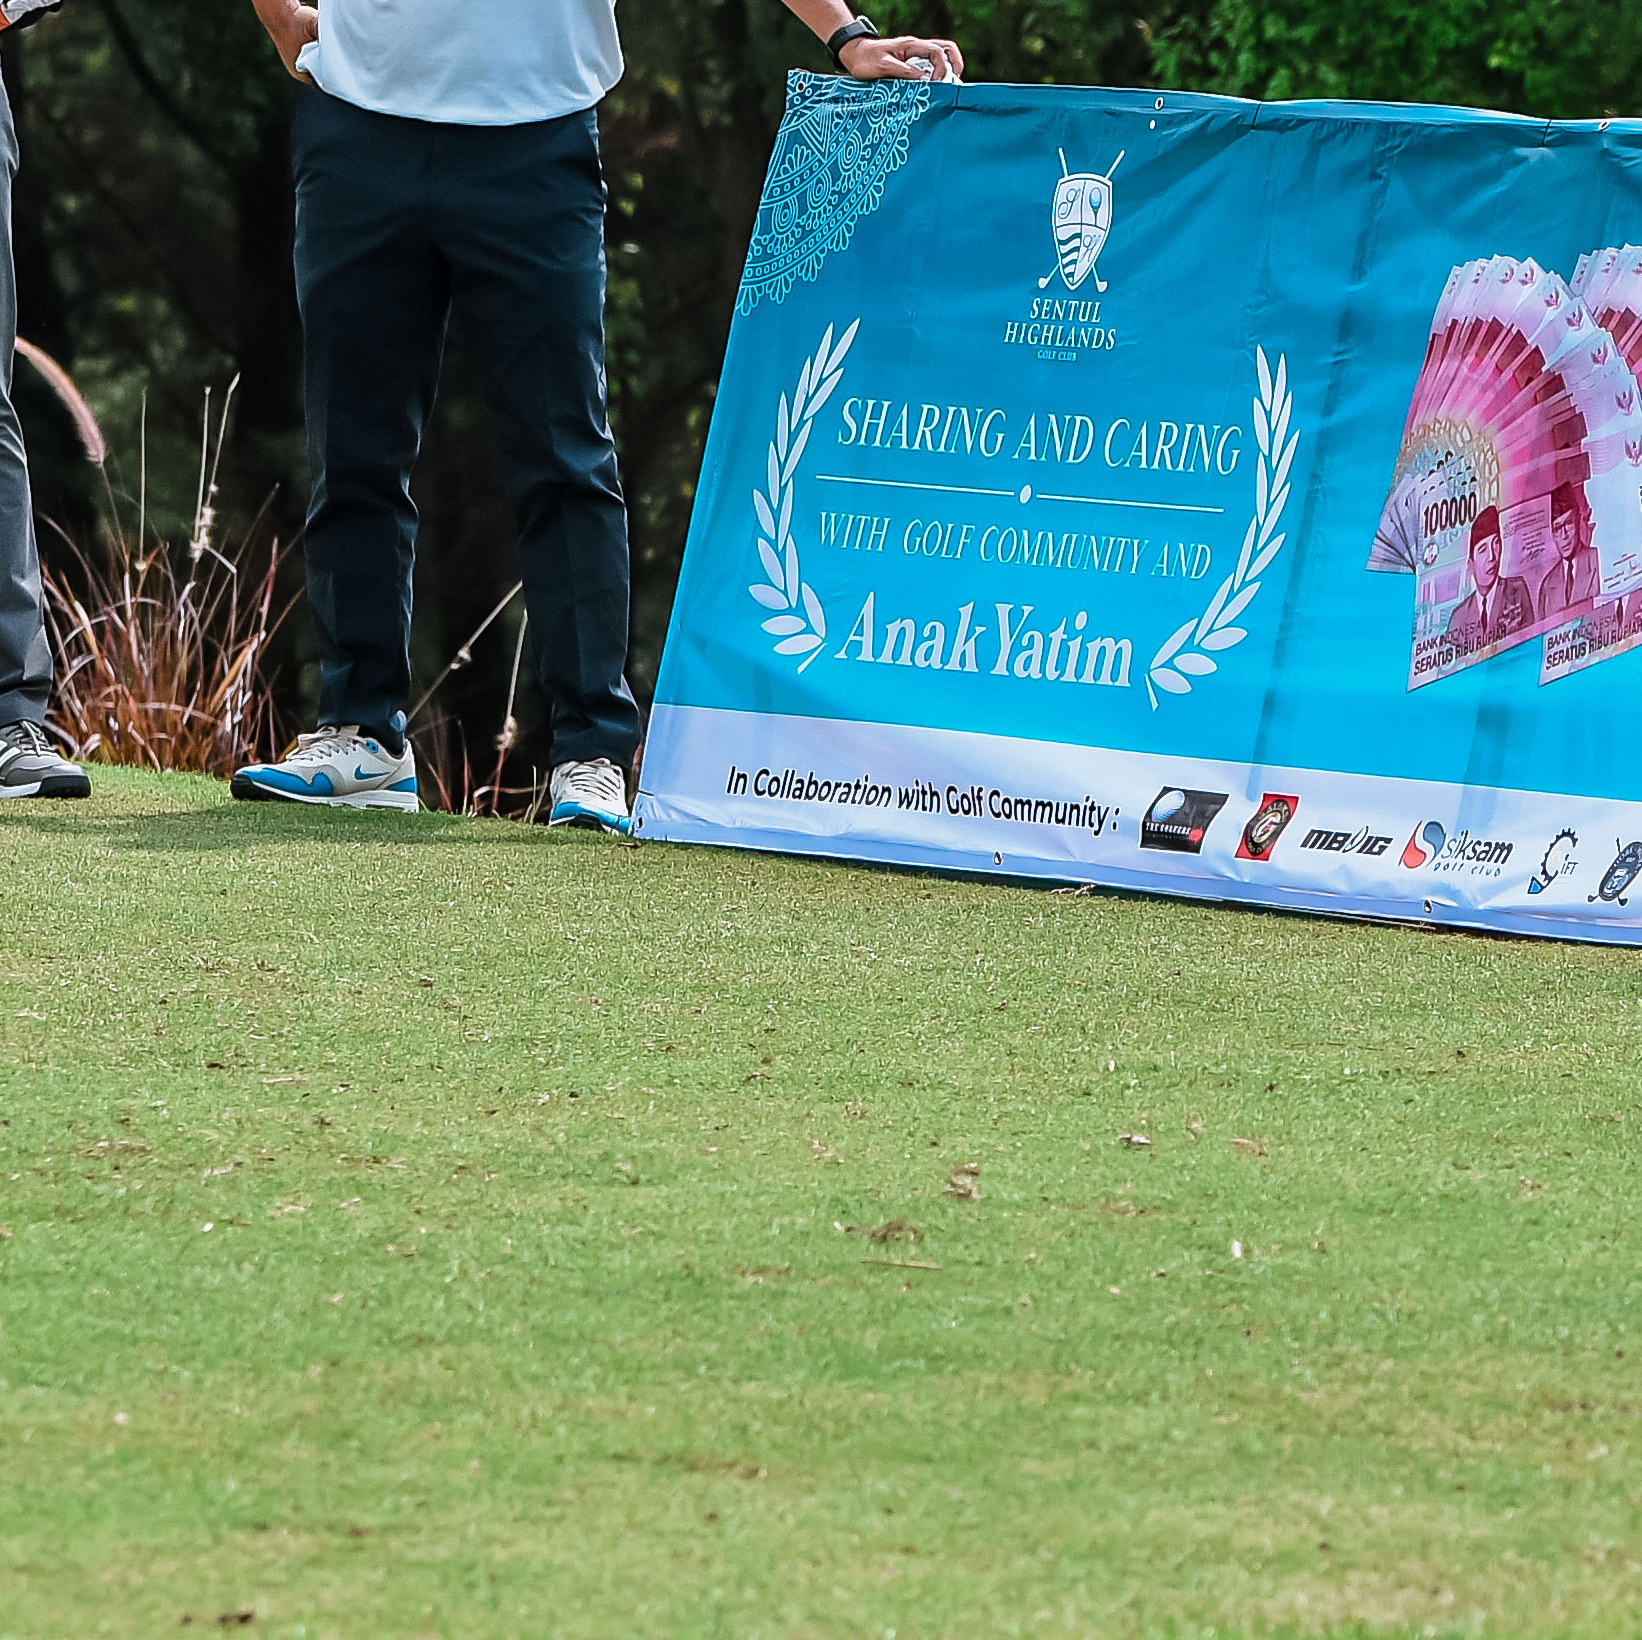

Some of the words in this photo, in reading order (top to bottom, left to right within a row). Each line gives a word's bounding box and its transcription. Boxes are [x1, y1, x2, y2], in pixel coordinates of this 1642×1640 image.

[1030, 297, 1101, 324] SENTUL
[1004, 322, 1117, 351] HIGHLANDS
[1038, 349, 1056, 360] GOLF
[1058, 350, 1077, 362] CLUB
[837, 396, 1007, 458] SHARING
[1012, 412, 1095, 464] AND
[1104, 417, 1243, 476] CARING
[1424, 491, 1477, 538] 100000
[819, 511, 891, 552] WITH
[903, 518, 975, 560] GOLF
[979, 525, 1149, 575] COMMUNITY
[1150, 542, 1211, 579] AND
[834, 591, 987, 673] Anak
[989, 602, 1133, 687] Yatim
[1414, 646, 1454, 676] SERATUS
[1455, 639, 1475, 661] RIBU
[1415, 635, 1438, 657] BANK
[1546, 641, 1587, 670] SERATUS
[1588, 632, 1610, 654] RIBU
[1547, 629, 1571, 651] BANK
[725, 765, 748, 796] In
[753, 768, 892, 809] Collaboration
[897, 778, 941, 814] with
[945, 784, 984, 819] Golf
[1440, 830, 1514, 865] siksam
